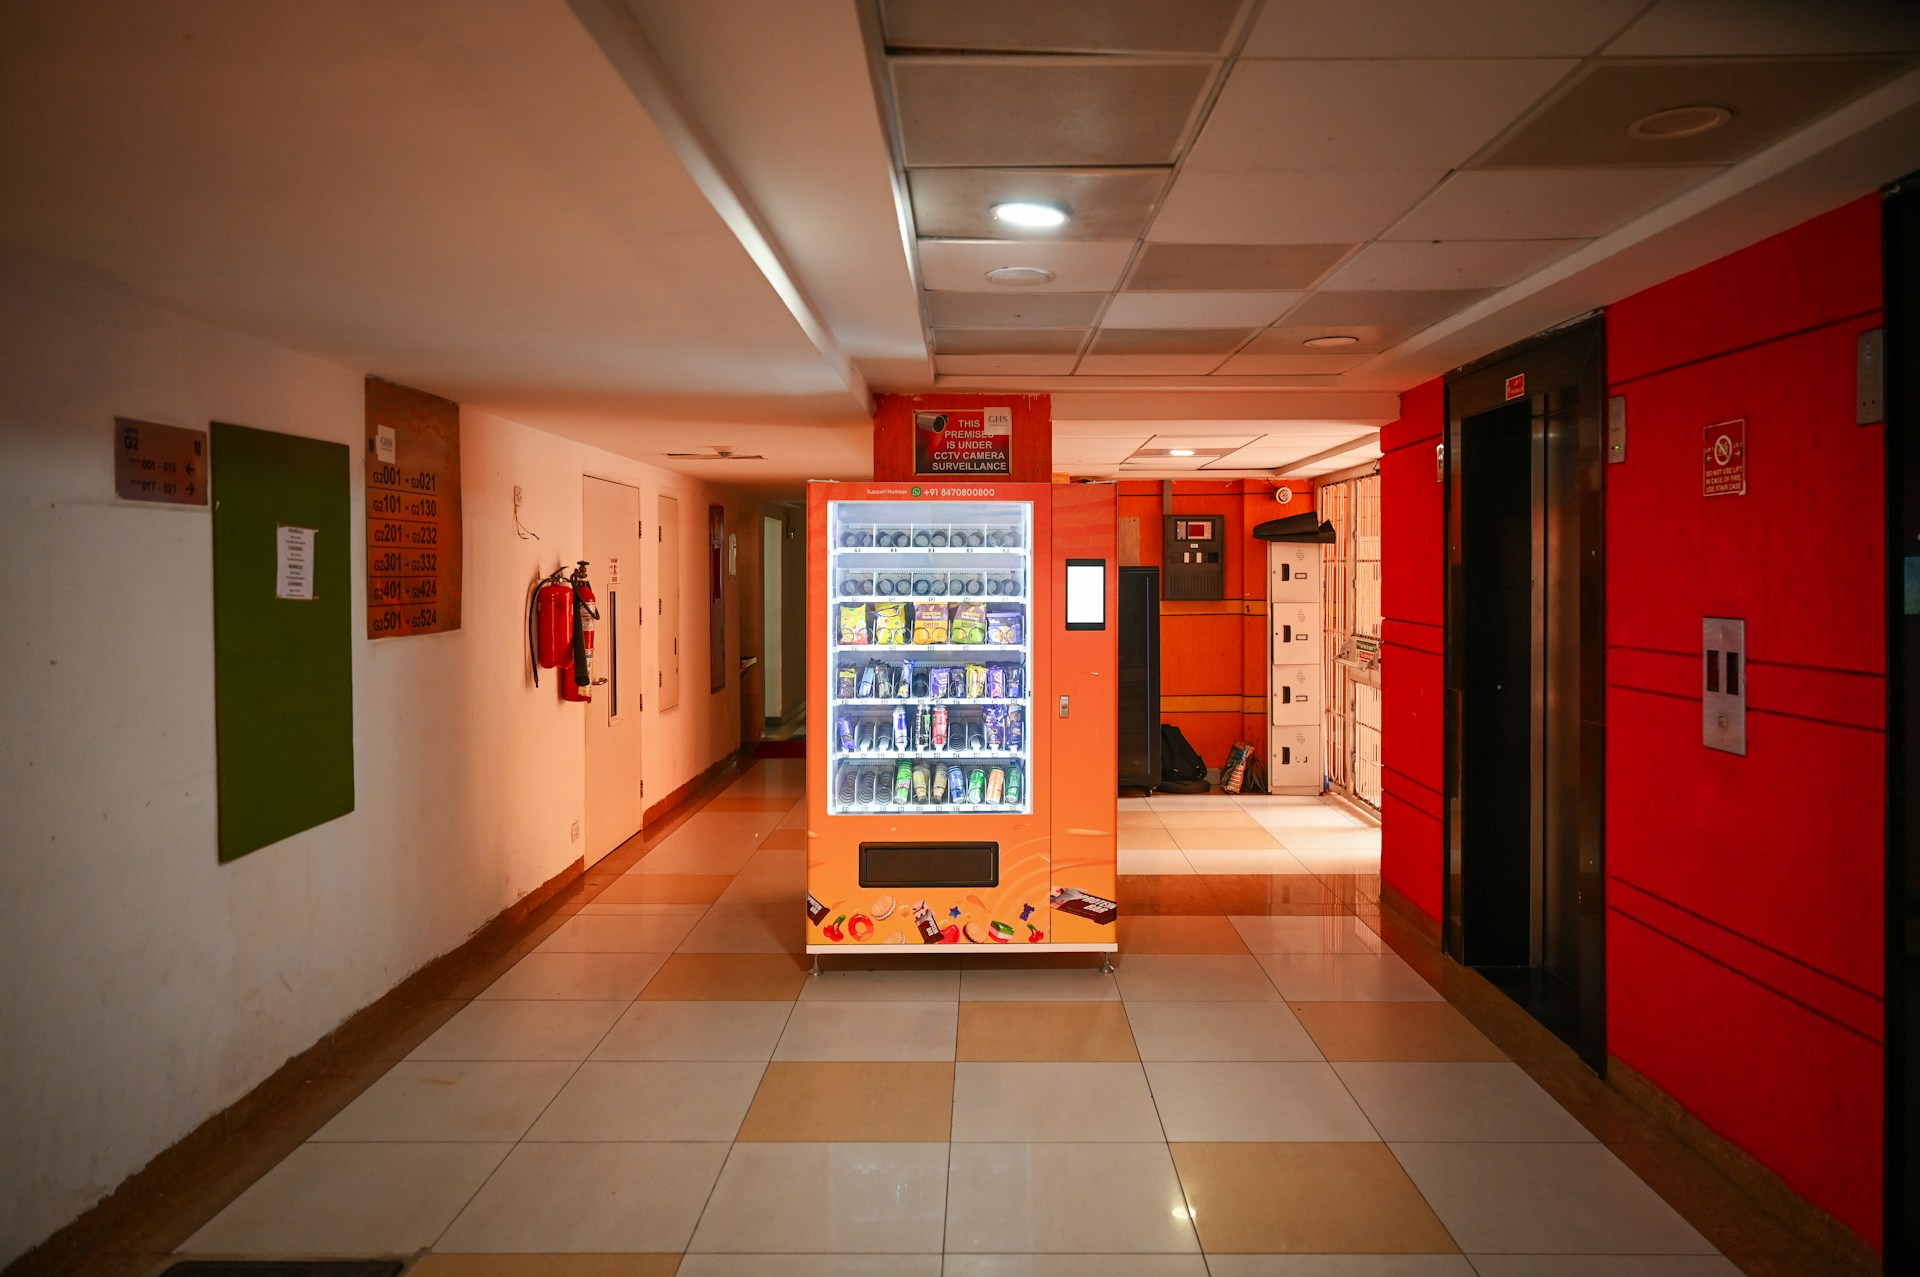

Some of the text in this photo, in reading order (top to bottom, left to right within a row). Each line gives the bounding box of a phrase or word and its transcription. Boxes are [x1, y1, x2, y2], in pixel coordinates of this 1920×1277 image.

[958, 419, 980, 428] THIS
[988, 415, 1008, 423] GHS
[124, 435, 139, 450] G2
[946, 440, 993, 449] IS UNDER
[933, 451, 1006, 460] CCTV CAMERA
[932, 462, 1007, 471] SURVEILLANCE
[1713, 468, 1723, 476] NOT
[1723, 467, 1732, 475] USE
[373, 466, 401, 486] G2001
[411, 472, 436, 491] G2021
[1711, 476, 1723, 484] CASE
[1715, 484, 1728, 492] STAIR
[1729, 482, 1742, 490] CASE
[866, 488, 887, 496] Support
[923, 488, 939, 497] +91
[941, 488, 995, 497] 8470800800
[373, 494, 401, 513] G2101
[411, 498, 437, 517] G2130
[374, 523, 402, 543] G2201
[412, 526, 437, 544] G2232
[374, 553, 401, 571] G2301
[411, 553, 437, 571] G2332
[374, 581, 401, 600] G2401
[411, 580, 437, 598] G2424
[373, 611, 401, 631] G2501
[412, 608, 437, 628] G2524
